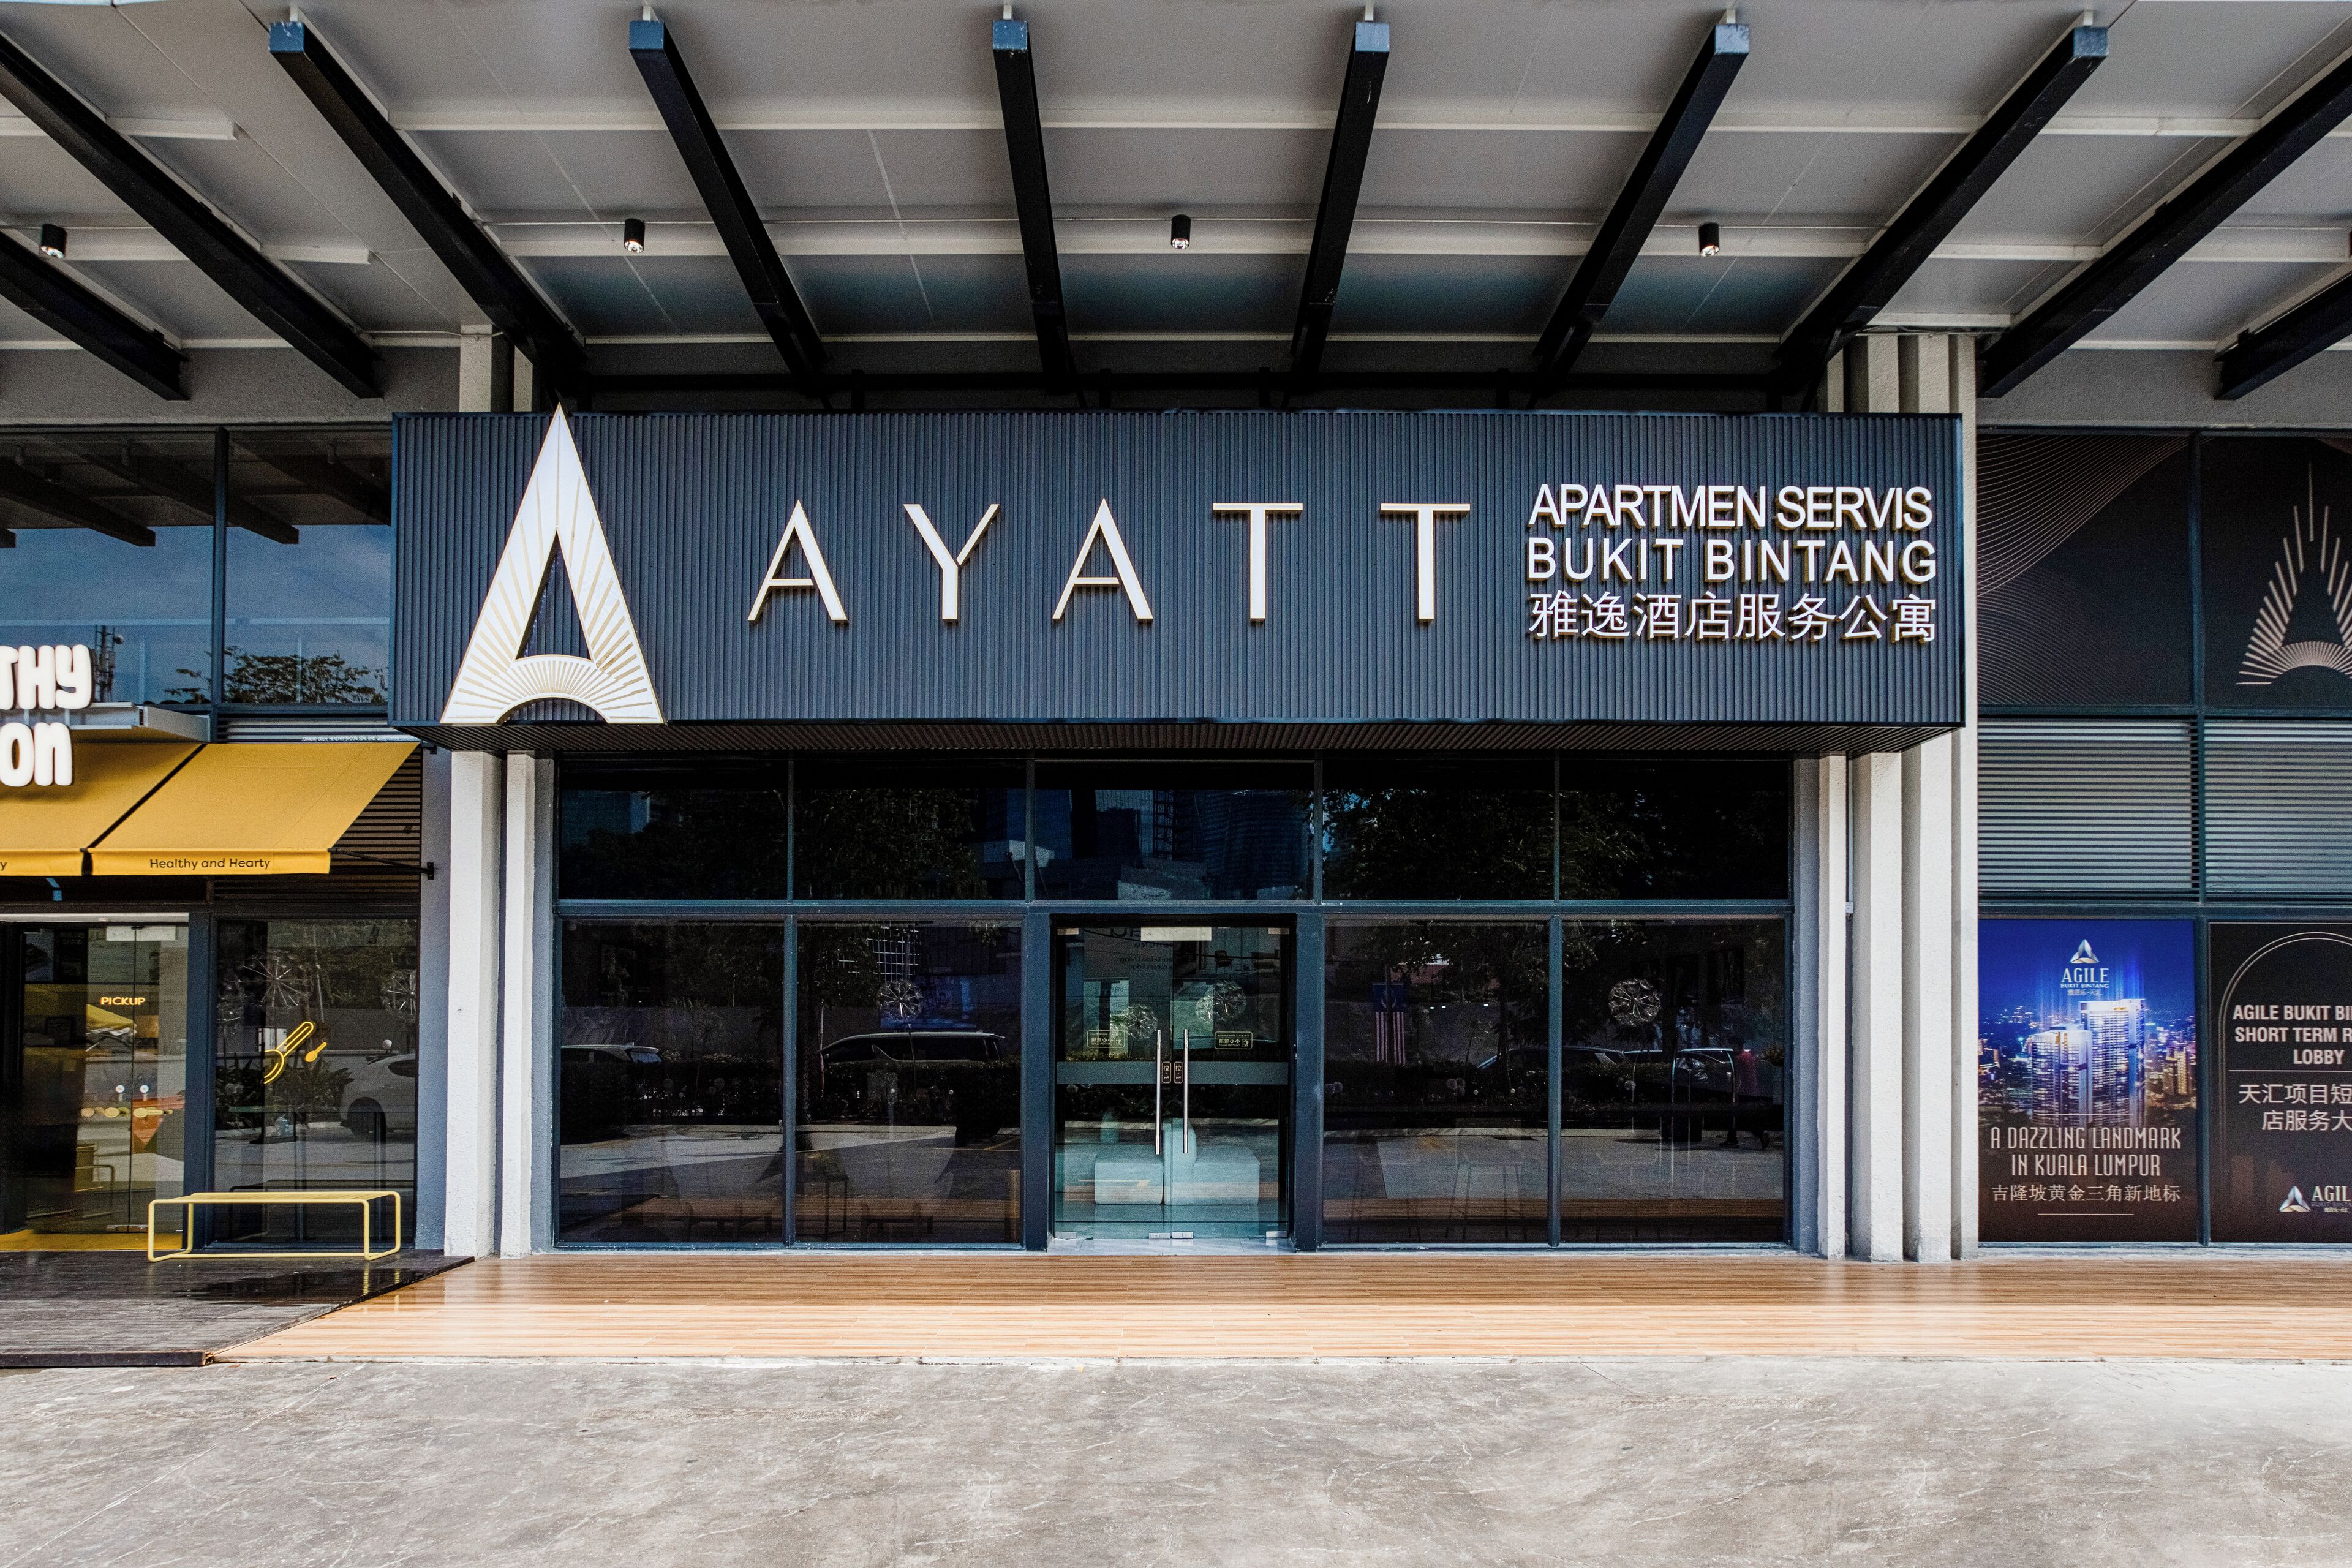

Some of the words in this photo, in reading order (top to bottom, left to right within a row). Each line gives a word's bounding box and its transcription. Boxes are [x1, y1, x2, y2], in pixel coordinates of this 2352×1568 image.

[1528, 484, 1766, 529] APARTMEN
[1776, 486, 1932, 530] SERVIS
[1528, 537, 1684, 581] BUKIT
[1705, 540, 1937, 583] BINTANG
[1529, 589, 1937, 643] 雅逸酒店服务公寓
[149, 858, 198, 870] Healthy
[201, 859, 225, 869] and
[229, 858, 271, 870] Hearty
[2060, 967, 2109, 983] AGILE
[100, 997, 146, 1006] PICKUP
[2233, 1005, 2279, 1020] AGILE
[2283, 1005, 2331, 1020] BUKIT
[2335, 1005, 2352, 1020] BI
[2234, 1027, 2289, 1042] SHORT
[2292, 1027, 2337, 1042] TERM
[2293, 1049, 2345, 1065] LOBBY
[2239, 1083, 2352, 1104] 天汇项目短
[2261, 1109, 2352, 1131] 店服务大
[1991, 1127, 2000, 1149] A
[2008, 1127, 2086, 1149] DAZZLING
[2092, 1127, 2181, 1150] LANDMARK
[2011, 1154, 2027, 1176] IN
[2035, 1154, 2088, 1176] KUALA
[2095, 1154, 2161, 1177] LUMPUR
[1991, 1184, 2180, 1202] 吉隆坡黄金三角新地标
